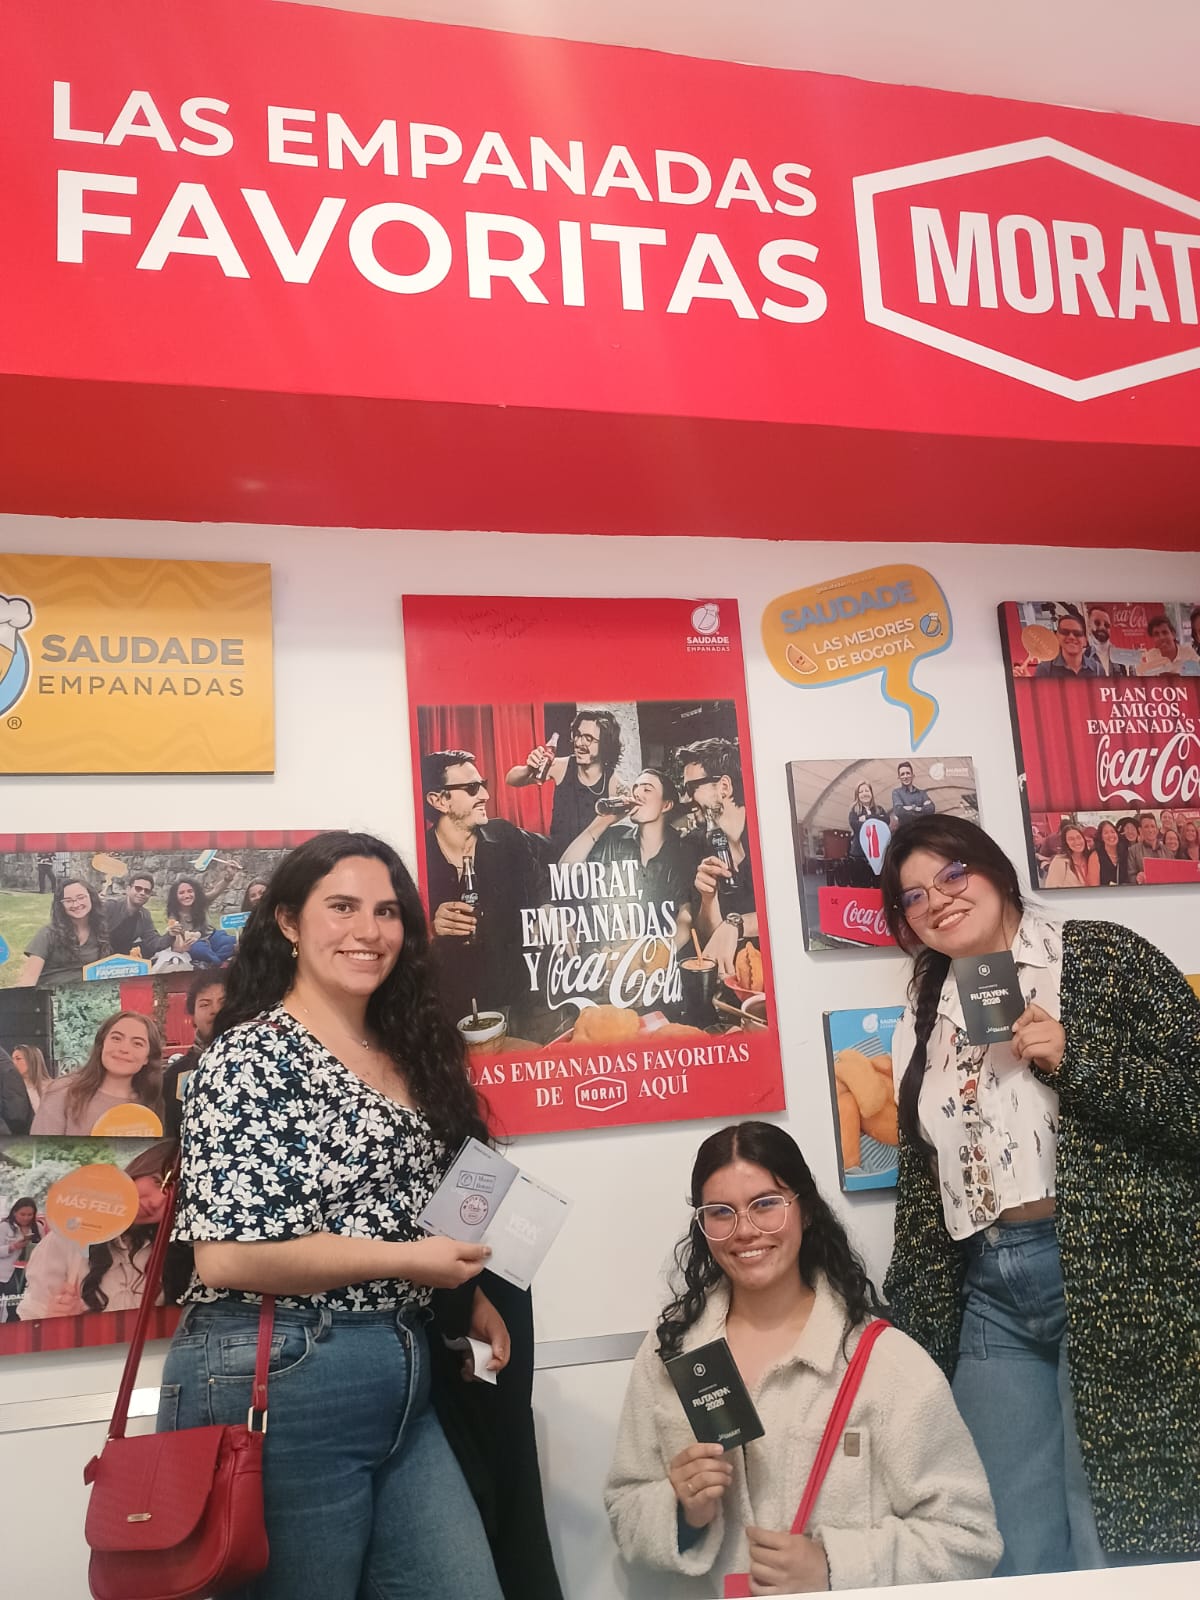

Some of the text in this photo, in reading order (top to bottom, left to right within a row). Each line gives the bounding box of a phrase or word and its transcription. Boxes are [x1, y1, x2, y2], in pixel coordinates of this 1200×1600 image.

[54, 80, 818, 217] LAS EMPANADAS
[56, 169, 828, 324] FAVORITAS
[910, 205, 1200, 326] MORAT
[780, 580, 918, 634] SAUDADE
[40, 634, 245, 666] SAUDADE
[686, 636, 730, 644] SAUDADE
[813, 617, 915, 656] LAS MEJORES
[825, 636, 916, 672] DE BOGOTÁ
[38, 675, 245, 697] EMPANADAS
[1099, 686, 1189, 702] PLAN CON
[1086, 719, 1196, 735] EMPANADAS
[1110, 702, 1187, 720] AMIGOS,
[1096, 732, 1200, 804] Coca-Co
[548, 859, 644, 902] MORAT,
[519, 900, 678, 948] EMPANADAS
[522, 934, 684, 1011] Y Coca-Cola
[464, 1042, 750, 1087] LAS EMPANADAS FAVORITAS
[535, 1068, 689, 1108] DE MORAT AQUÍ
